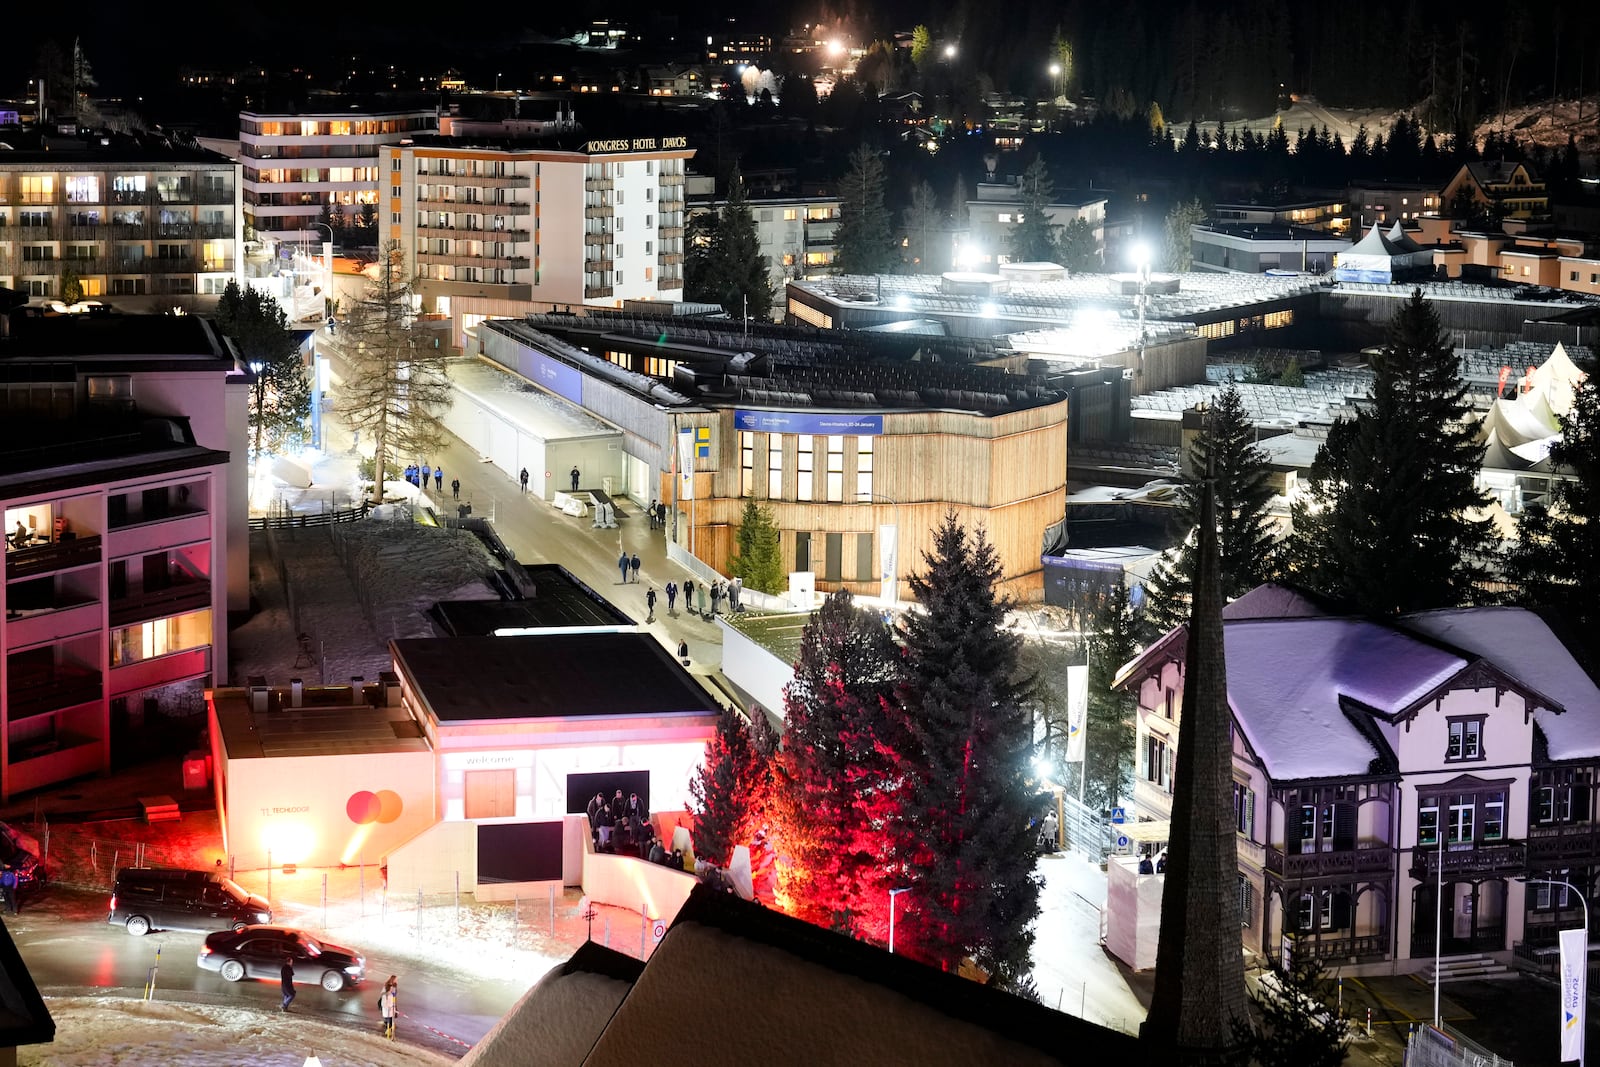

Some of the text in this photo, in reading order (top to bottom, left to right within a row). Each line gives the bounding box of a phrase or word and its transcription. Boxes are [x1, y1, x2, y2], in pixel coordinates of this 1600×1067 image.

[588, 137, 686, 152] KONGRESS HOTEL DAVOS
[466, 755, 514, 764] welcome
